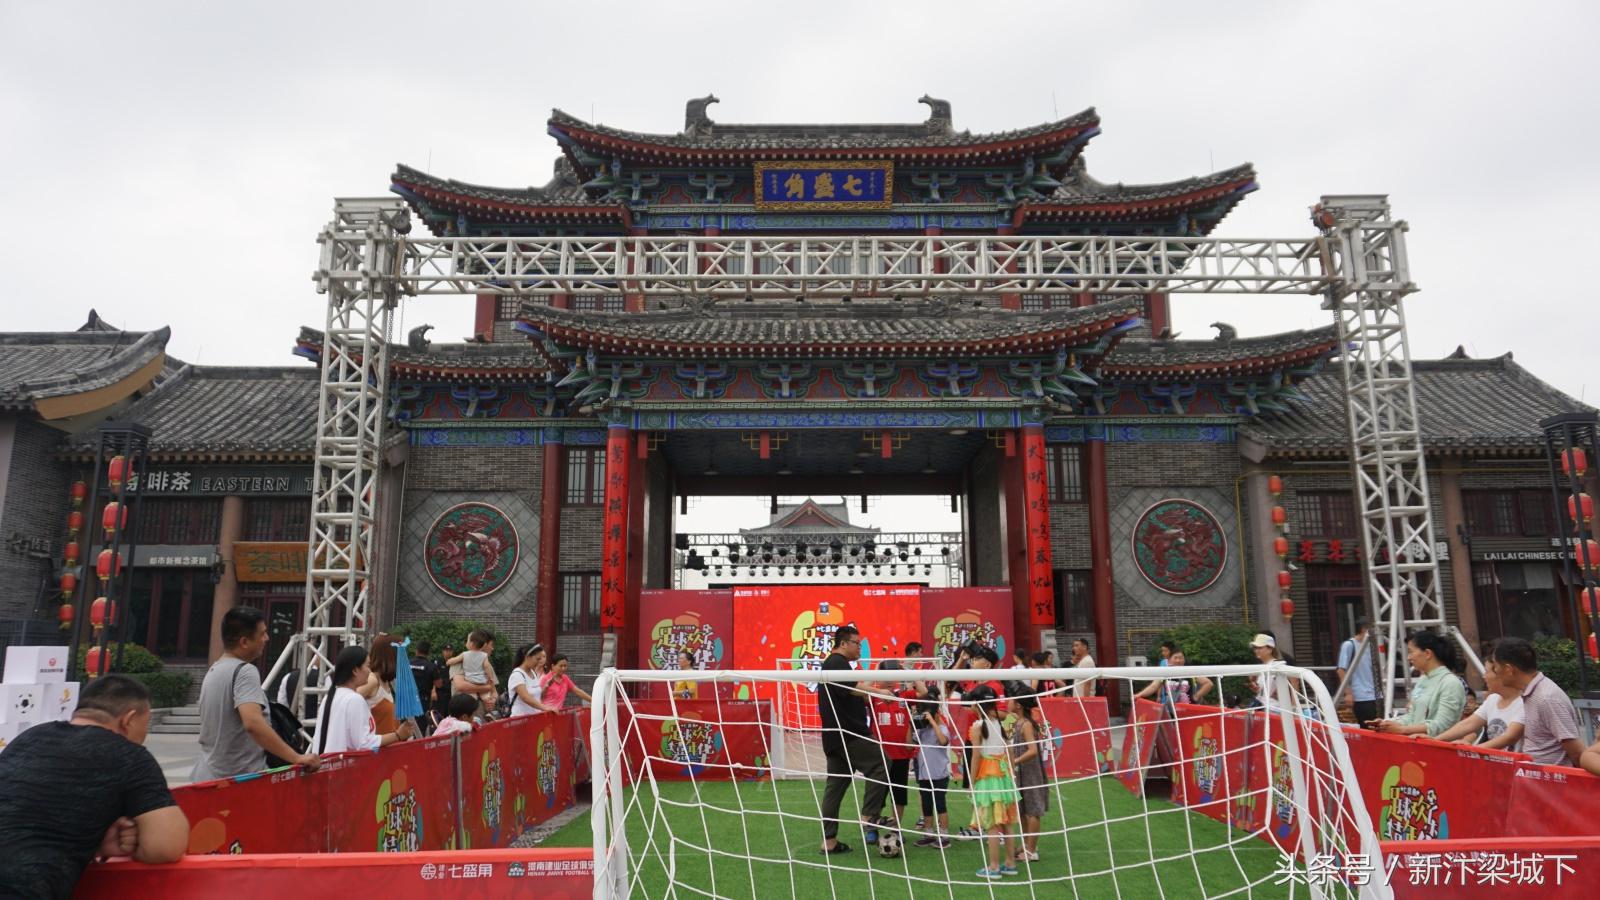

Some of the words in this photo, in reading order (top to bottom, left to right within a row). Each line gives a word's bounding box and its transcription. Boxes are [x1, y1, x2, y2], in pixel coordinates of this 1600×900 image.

[201, 477, 290, 491] EASTERN
[1484, 552, 1499, 560] LAI
[1501, 552, 1516, 560] LAI
[1519, 551, 1556, 560] CHINESE
[448, 863, 493, 879] 七盛角
